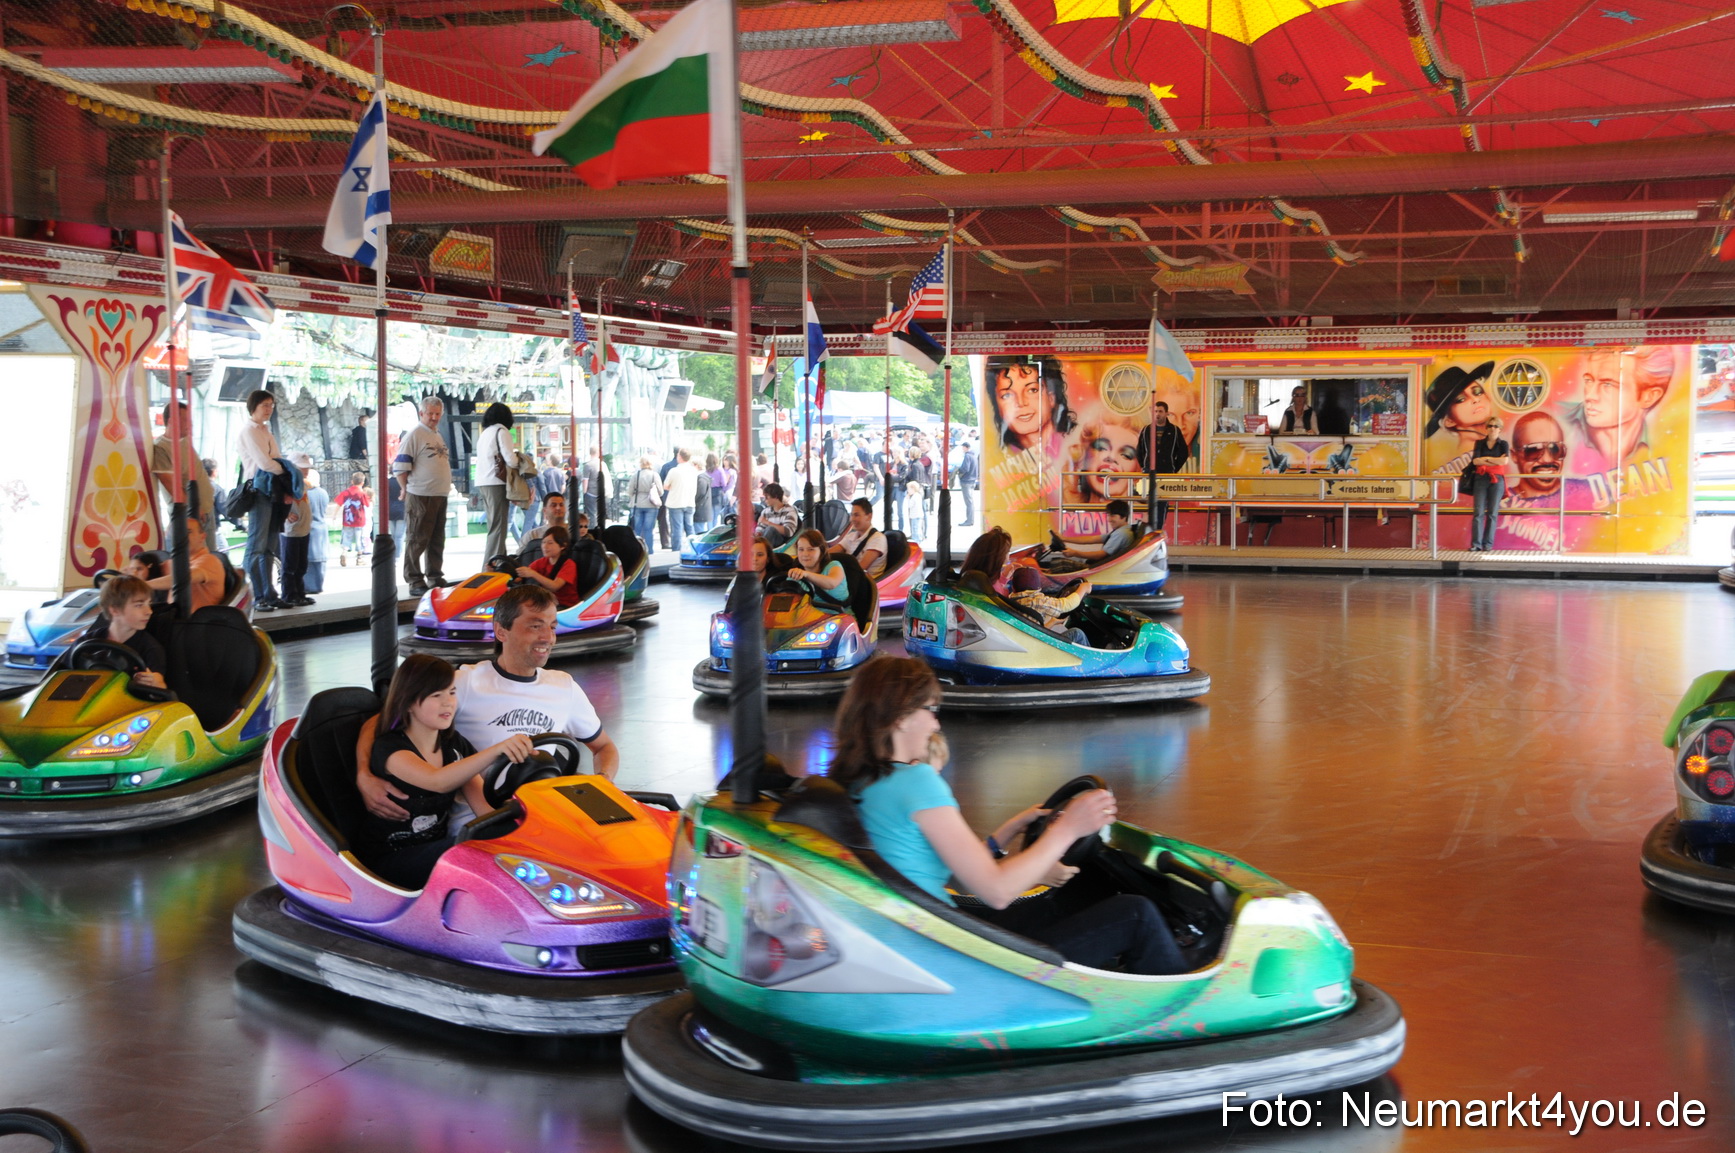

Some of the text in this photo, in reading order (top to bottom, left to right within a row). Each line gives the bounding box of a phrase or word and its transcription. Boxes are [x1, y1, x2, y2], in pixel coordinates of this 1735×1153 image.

[1165, 483, 1213, 493] rechts fahren
[1586, 457, 1674, 509] DEAN
[1345, 485, 1395, 494] rechts fahren
